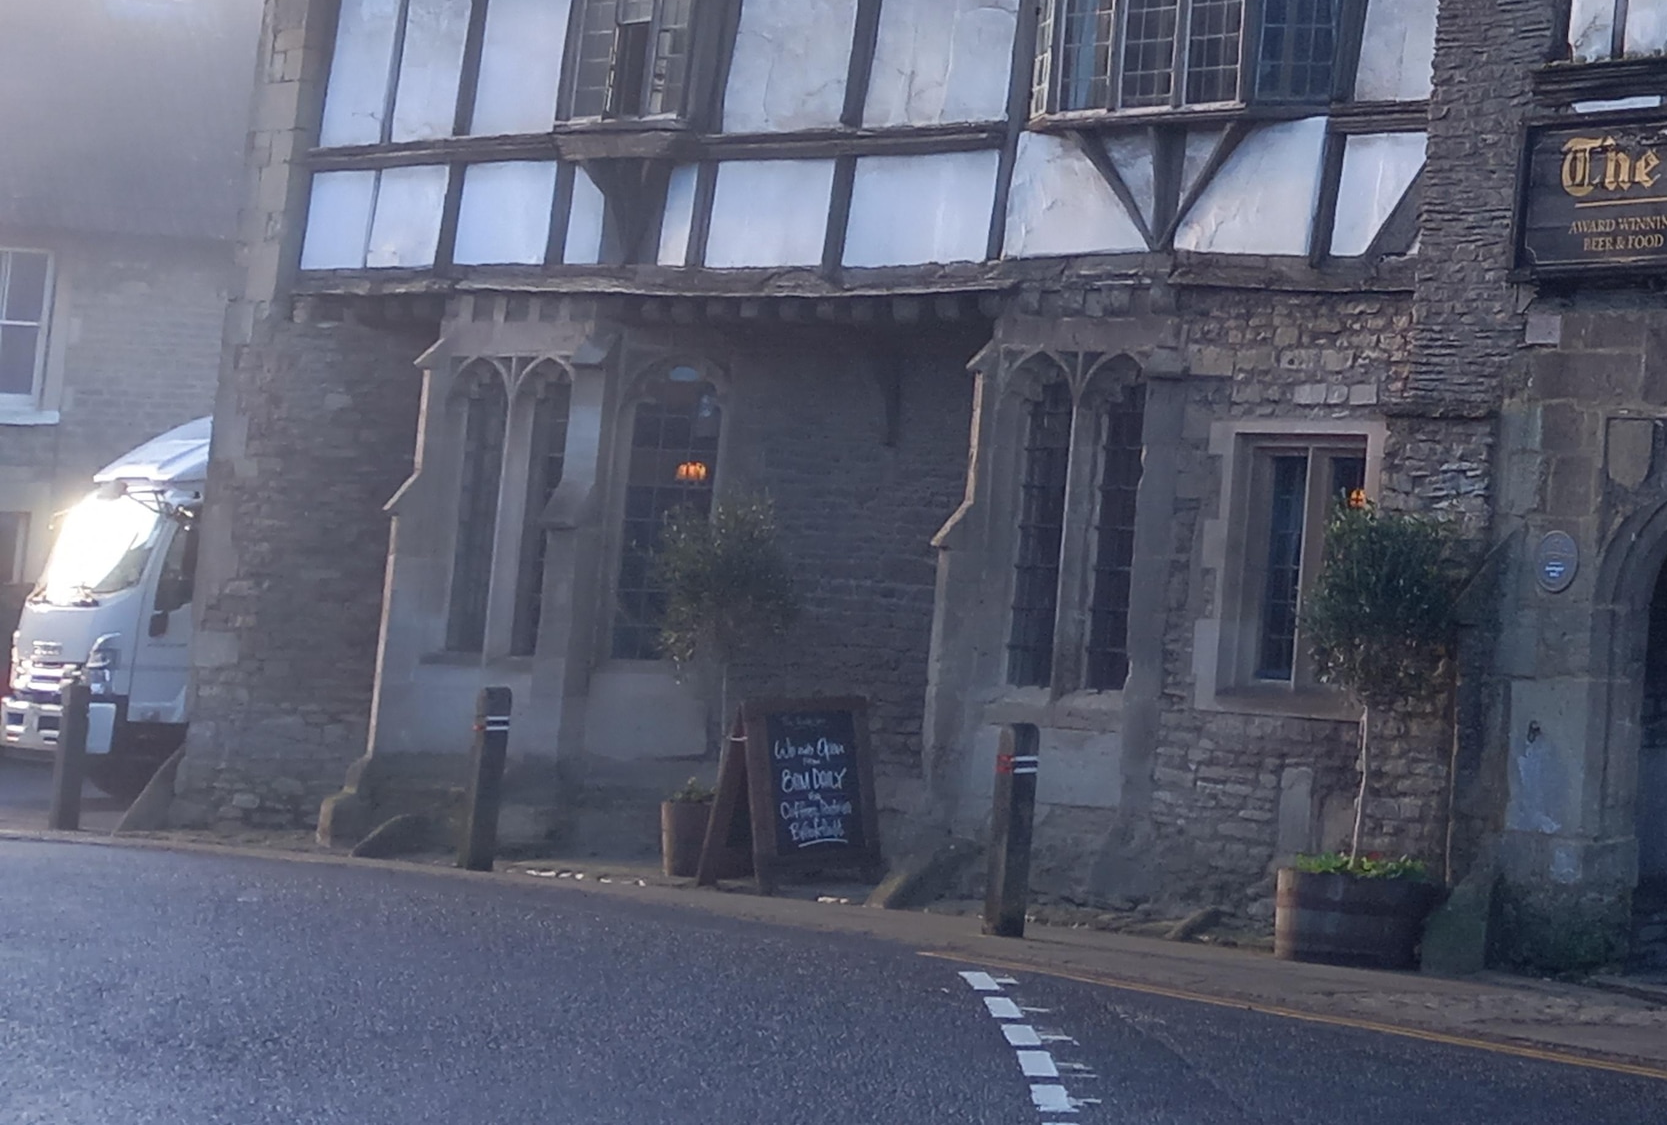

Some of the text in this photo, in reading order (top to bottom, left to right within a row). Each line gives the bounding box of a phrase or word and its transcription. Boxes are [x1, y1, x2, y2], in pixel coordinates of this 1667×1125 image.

[1561, 136, 1661, 196] The
[1568, 219, 1616, 235] AWARD
[1583, 233, 1664, 252] BEER & FOOD
